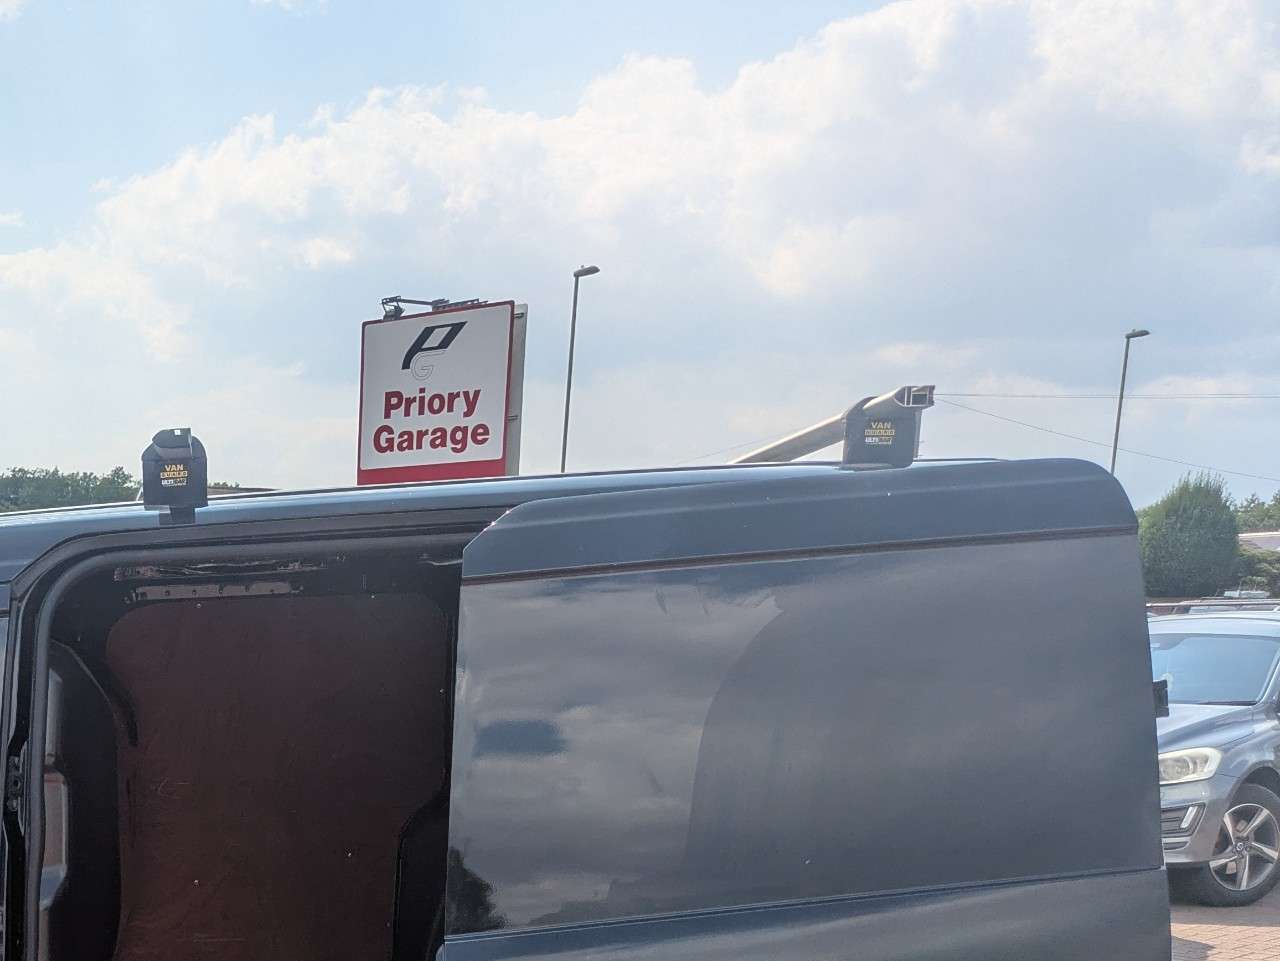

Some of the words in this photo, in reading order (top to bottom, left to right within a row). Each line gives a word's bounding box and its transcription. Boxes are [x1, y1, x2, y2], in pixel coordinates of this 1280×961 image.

[384, 387, 481, 419] Priory
[373, 423, 490, 453] Garage
[871, 421, 892, 429] VAN
